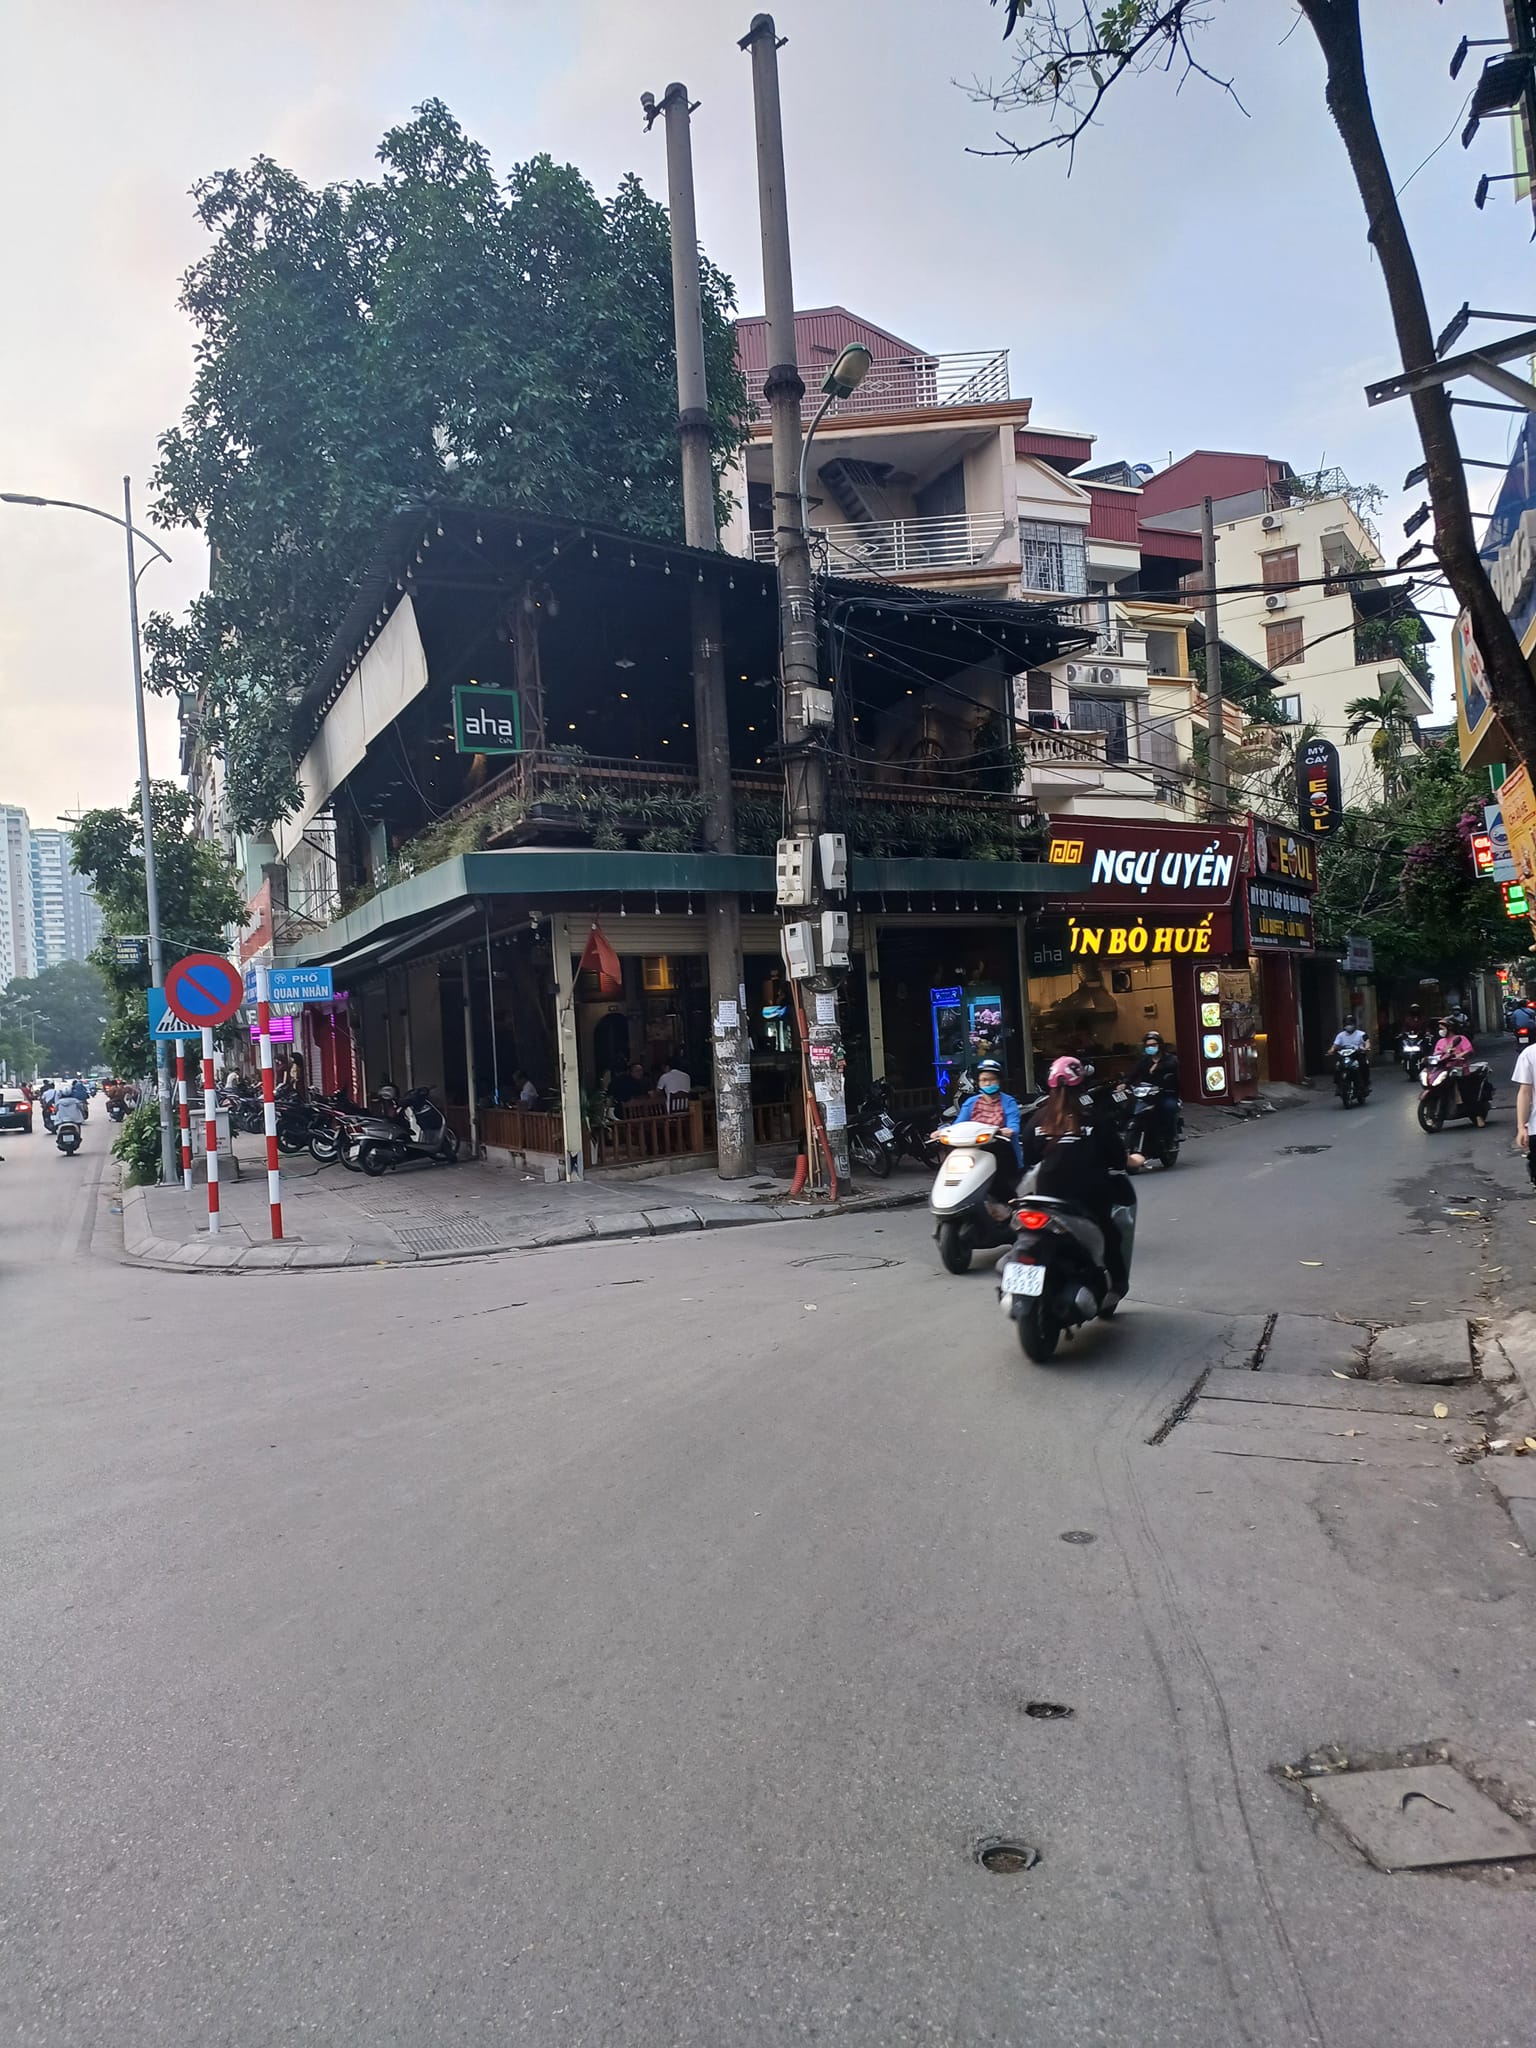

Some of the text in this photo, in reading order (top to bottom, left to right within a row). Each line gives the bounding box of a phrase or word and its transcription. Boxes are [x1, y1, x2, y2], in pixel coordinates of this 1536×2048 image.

[466, 707, 512, 736] aha
[1305, 755, 1329, 765] CAY
[1091, 840, 1234, 893] NGỰ UYỂN
[1106, 917, 1149, 956] BÒ
[1151, 911, 1214, 954] HUẾ
[1033, 943, 1063, 964] aha
[291, 971, 319, 984] PHỐ
[273, 984, 329, 1000] QUAN NHÂN
